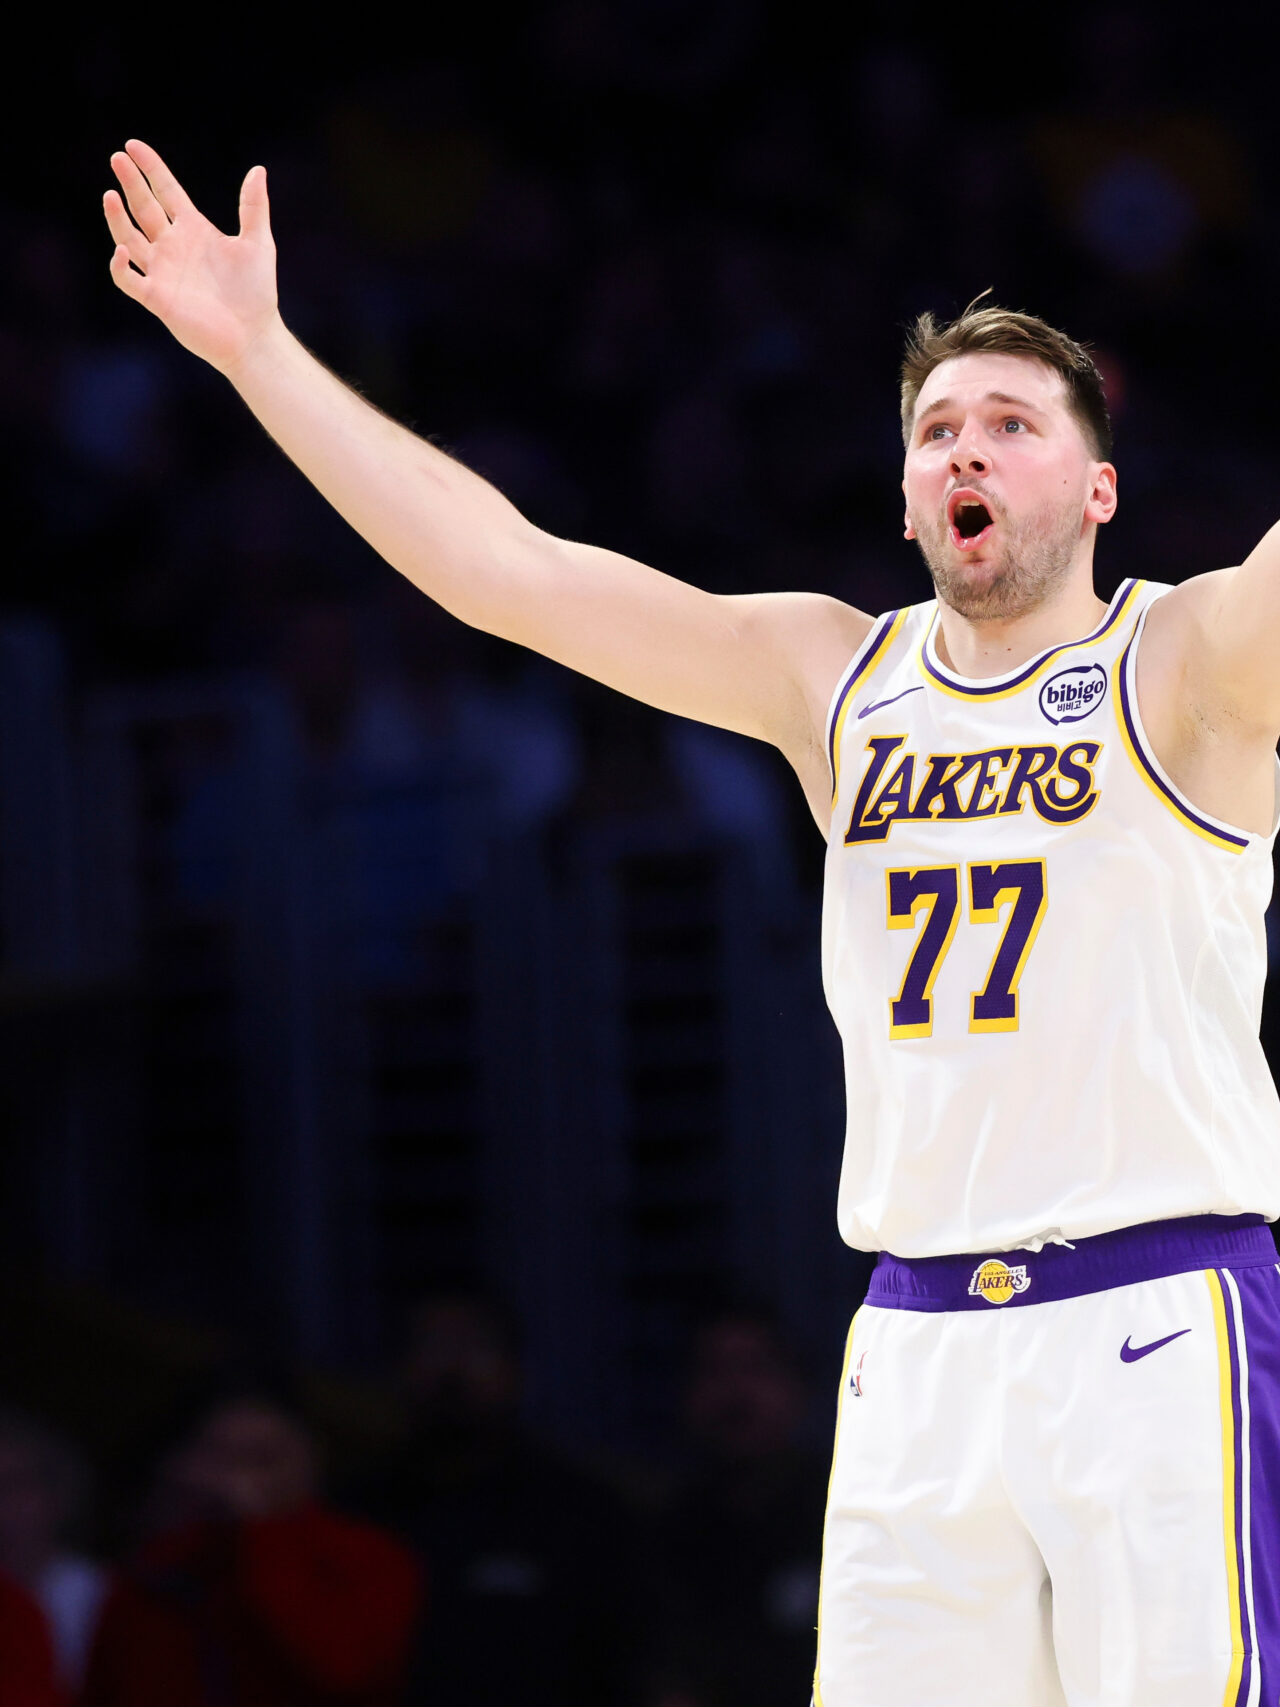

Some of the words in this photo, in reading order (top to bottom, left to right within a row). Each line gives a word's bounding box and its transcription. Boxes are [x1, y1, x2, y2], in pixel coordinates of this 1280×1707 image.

[1047, 680, 1104, 703] bibigo
[1057, 700, 1081, 712] 비비고
[844, 733, 1104, 847] LAKERS
[885, 857, 1048, 1040] 77
[973, 1272, 1028, 1292] LAKERS
